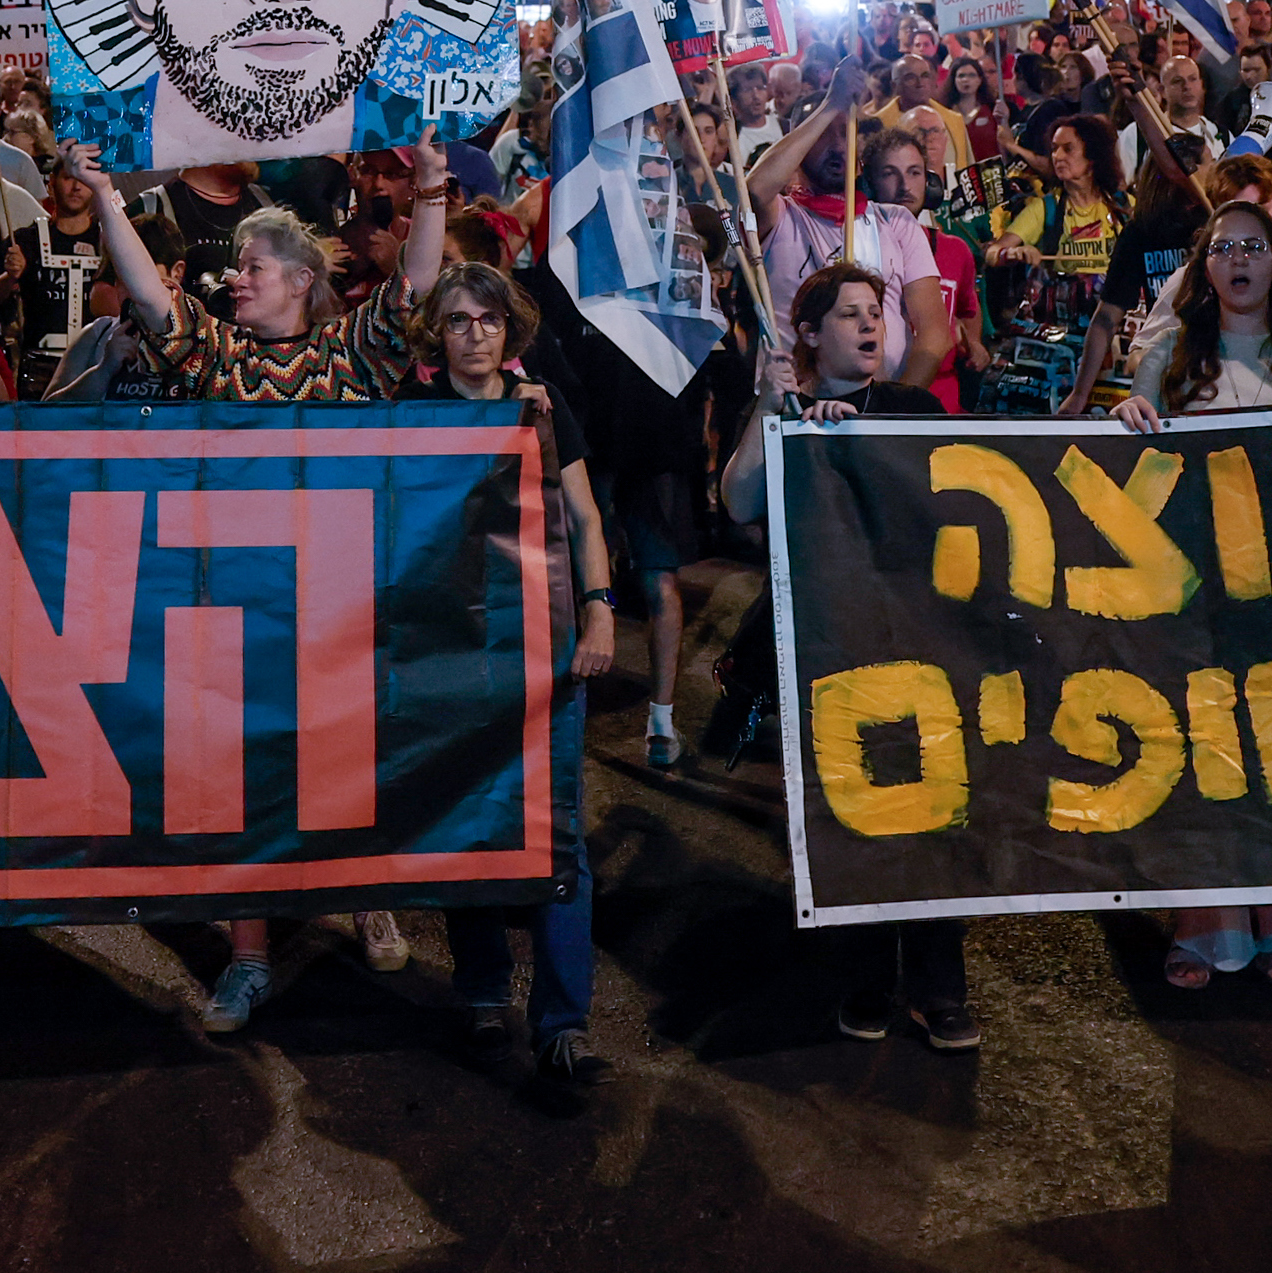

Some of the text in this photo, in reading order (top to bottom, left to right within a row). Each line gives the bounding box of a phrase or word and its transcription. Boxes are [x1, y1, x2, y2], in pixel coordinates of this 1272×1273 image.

[654, 1, 677, 22] ING
[429, 71, 494, 115] אלון
[1144, 248, 1188, 274] BRING
